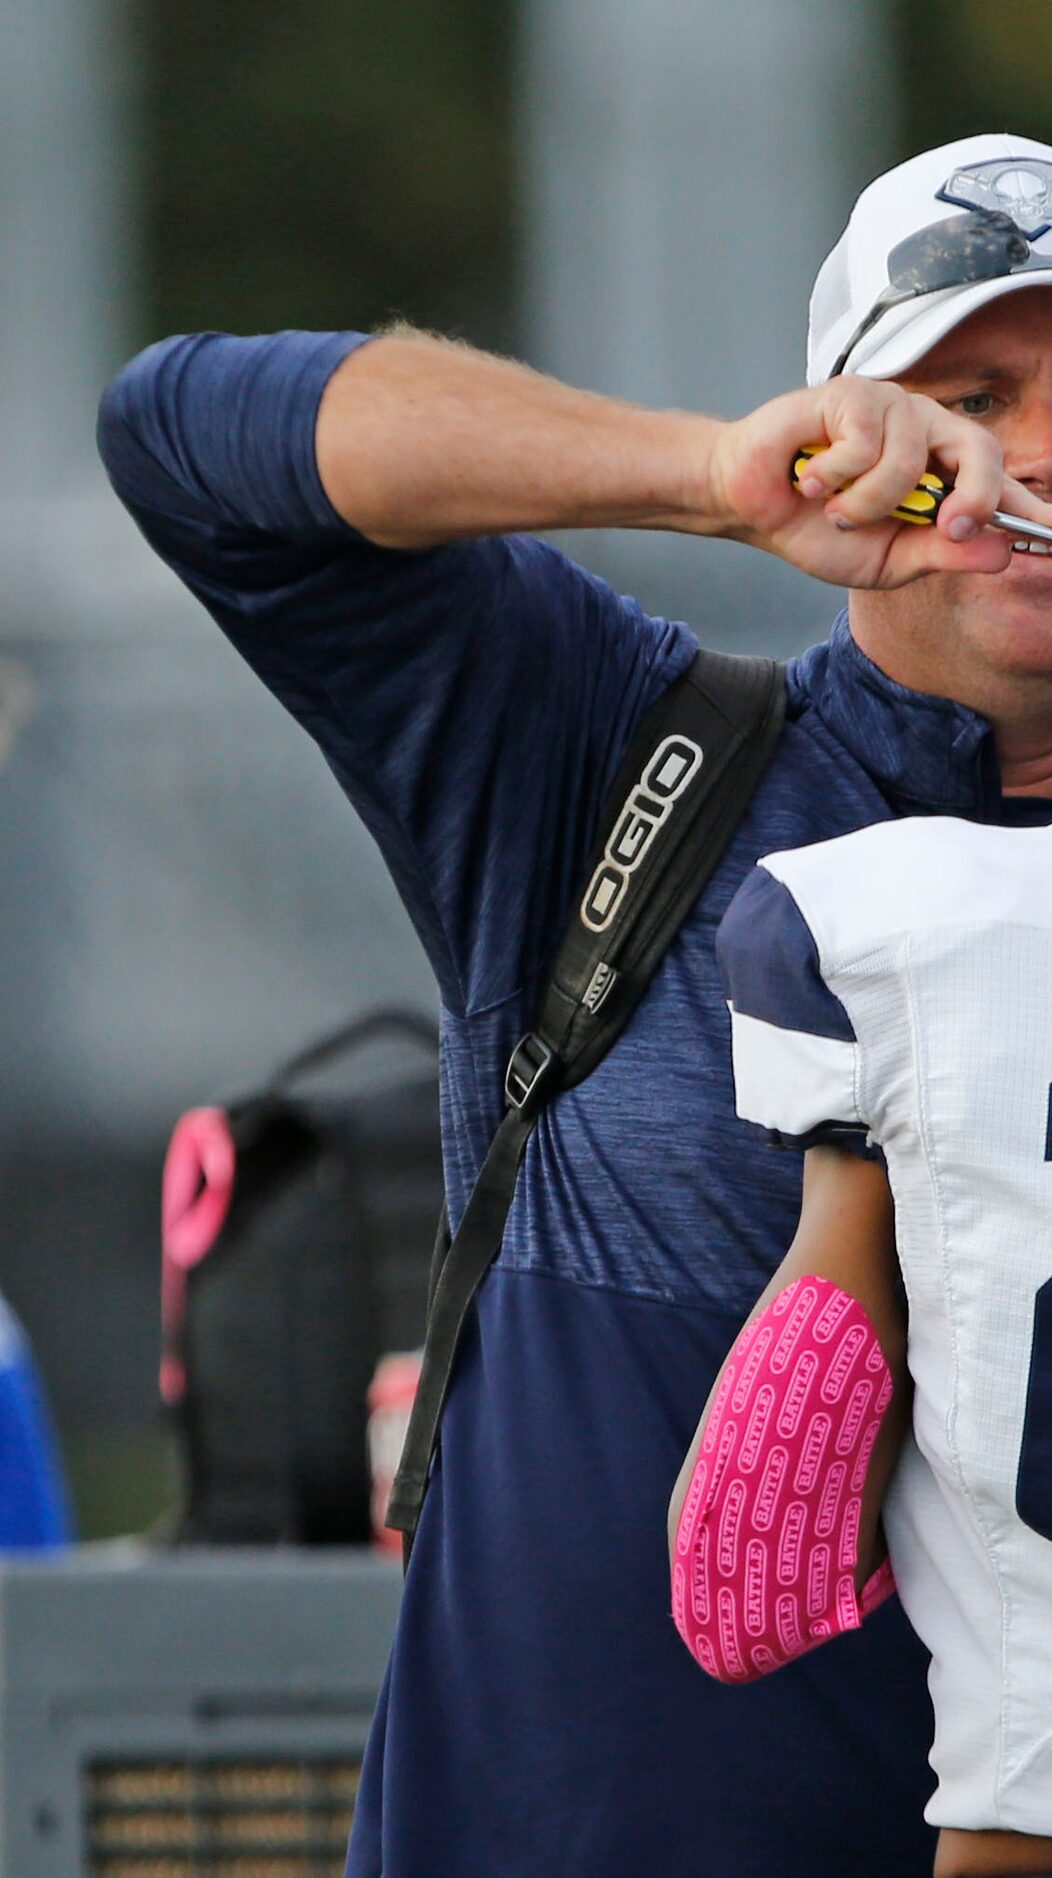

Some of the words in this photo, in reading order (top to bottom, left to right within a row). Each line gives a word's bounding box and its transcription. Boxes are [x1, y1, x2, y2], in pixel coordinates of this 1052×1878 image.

[581, 735, 704, 933] OGIO
[773, 1292, 814, 1368] BATTLE
[816, 1290, 851, 1337] BATT
[780, 1356, 815, 1432] BATTLE
[825, 1329, 863, 1399] BATTLE
[742, 1391, 772, 1467] BATTLE
[840, 1384, 870, 1449] BATTLE
[800, 1418, 828, 1487] BATTLE
[755, 1452, 786, 1525] BATTLE
[818, 1466, 844, 1530] BATTLE
[720, 1486, 743, 1568] BATTLE
[782, 1507, 804, 1577] BATTLE
[747, 1546, 763, 1628] BATTLE
[811, 1550, 827, 1613] BATTLE
